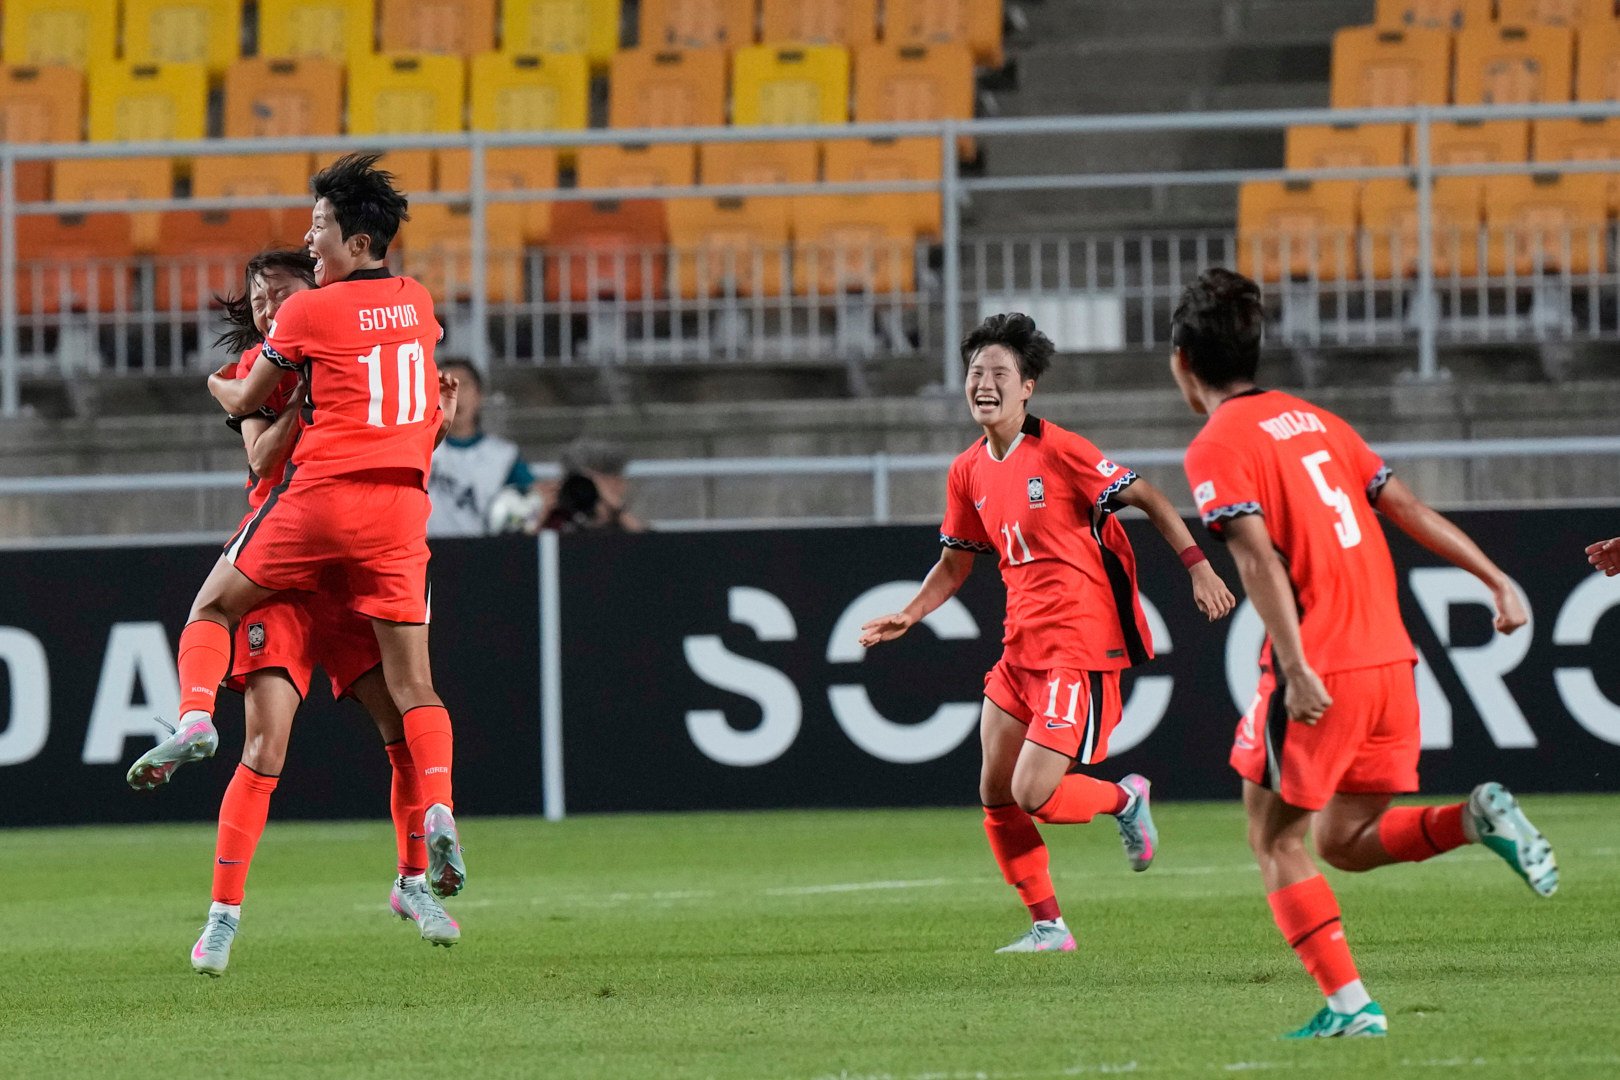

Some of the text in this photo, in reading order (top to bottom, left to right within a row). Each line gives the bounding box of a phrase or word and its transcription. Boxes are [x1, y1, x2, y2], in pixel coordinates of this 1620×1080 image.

[358, 304, 419, 331] SOYUN
[357, 338, 427, 427] 10
[1301, 449, 1362, 549] 5
[1001, 520, 1035, 566] 11
[191, 685, 214, 697] KOREA
[1043, 677, 1081, 725] 11
[424, 766, 449, 775] KOREA
